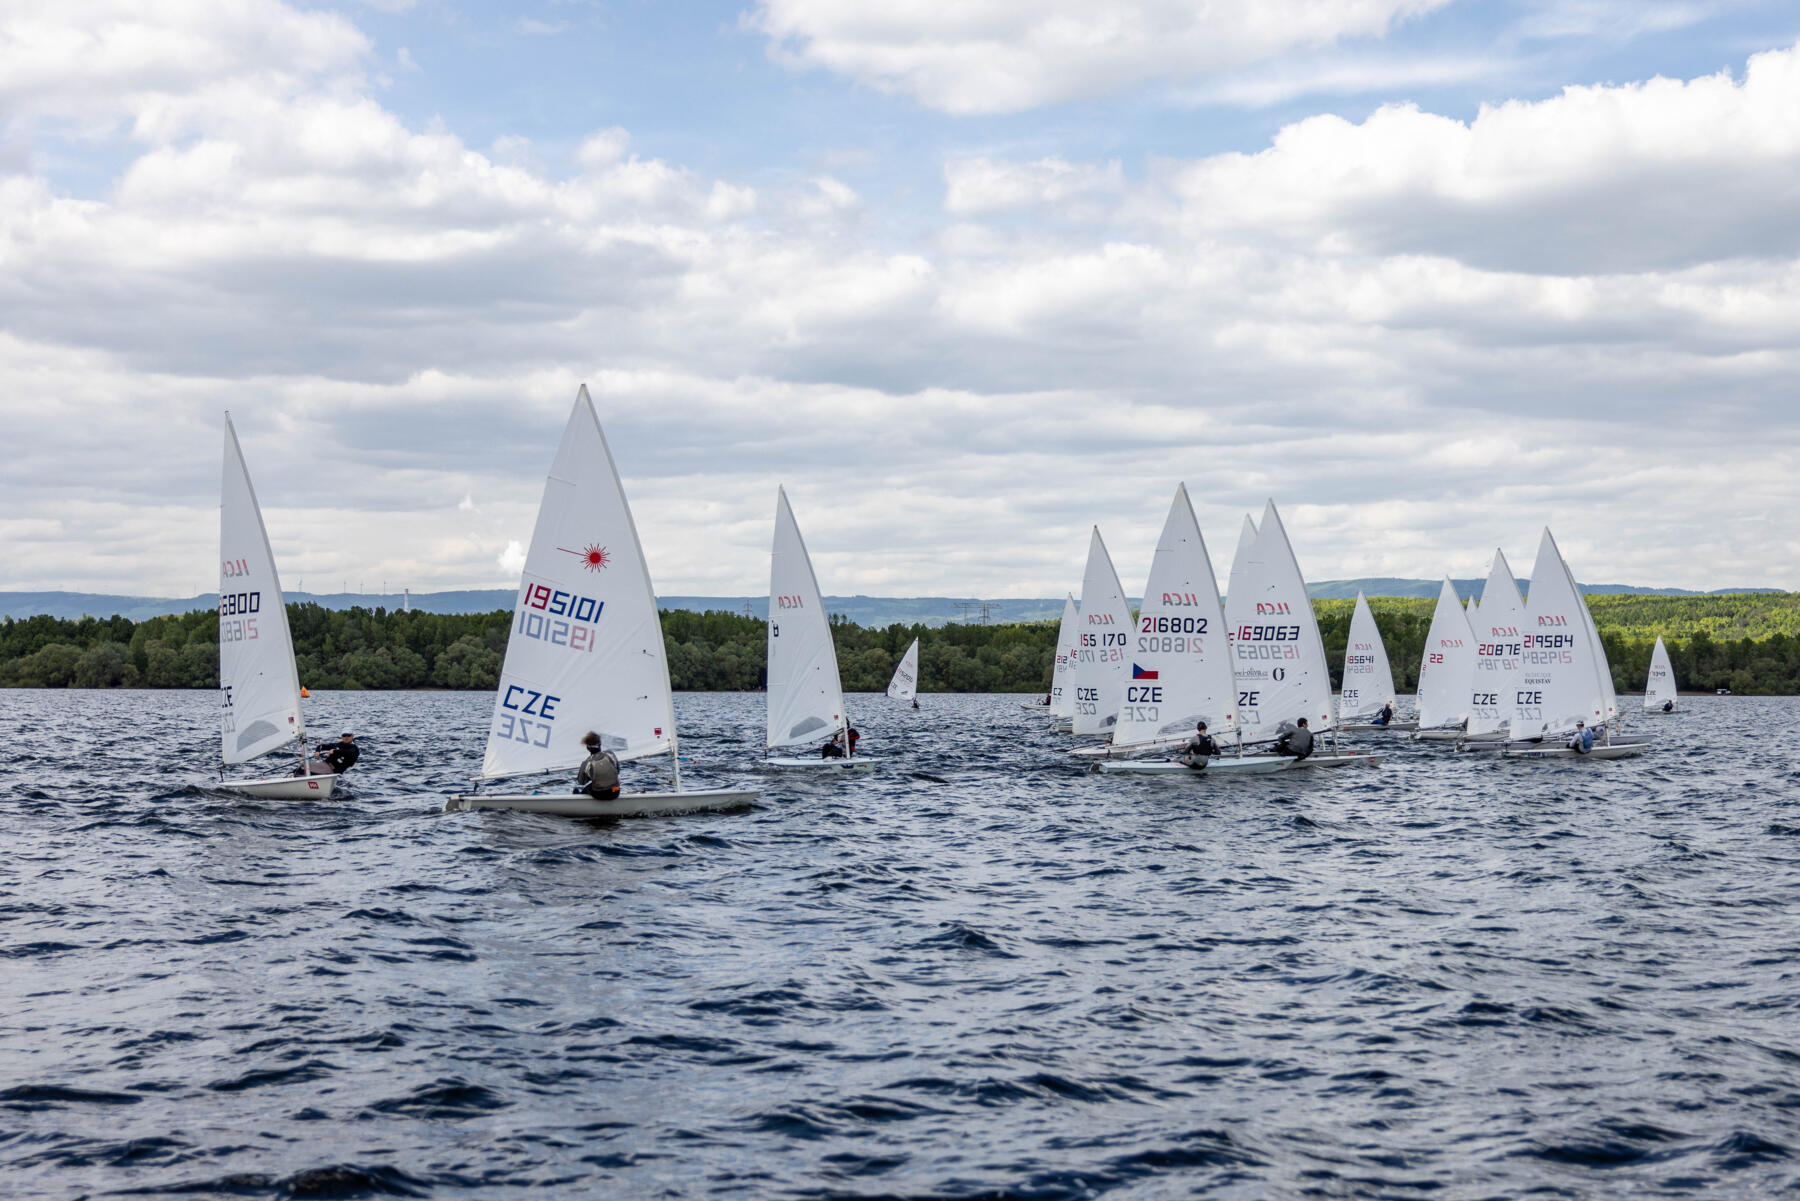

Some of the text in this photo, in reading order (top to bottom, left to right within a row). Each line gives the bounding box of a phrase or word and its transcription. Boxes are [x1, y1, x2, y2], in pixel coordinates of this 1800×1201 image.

[220, 592, 260, 616] 6800
[524, 583, 604, 624] 195101
[1141, 617, 1208, 634] 216802
[1237, 625, 1300, 641] 169063
[1523, 634, 1574, 649] 219584
[1347, 655, 1374, 664] 185641
[1429, 653, 1444, 664] 22
[1077, 688, 1099, 701] CZE
[1127, 687, 1163, 703] CZE
[1343, 689, 1359, 698] CZE
[1472, 693, 1498, 705] CZE
[1516, 691, 1542, 705] CZE
[503, 685, 561, 721] CZE
